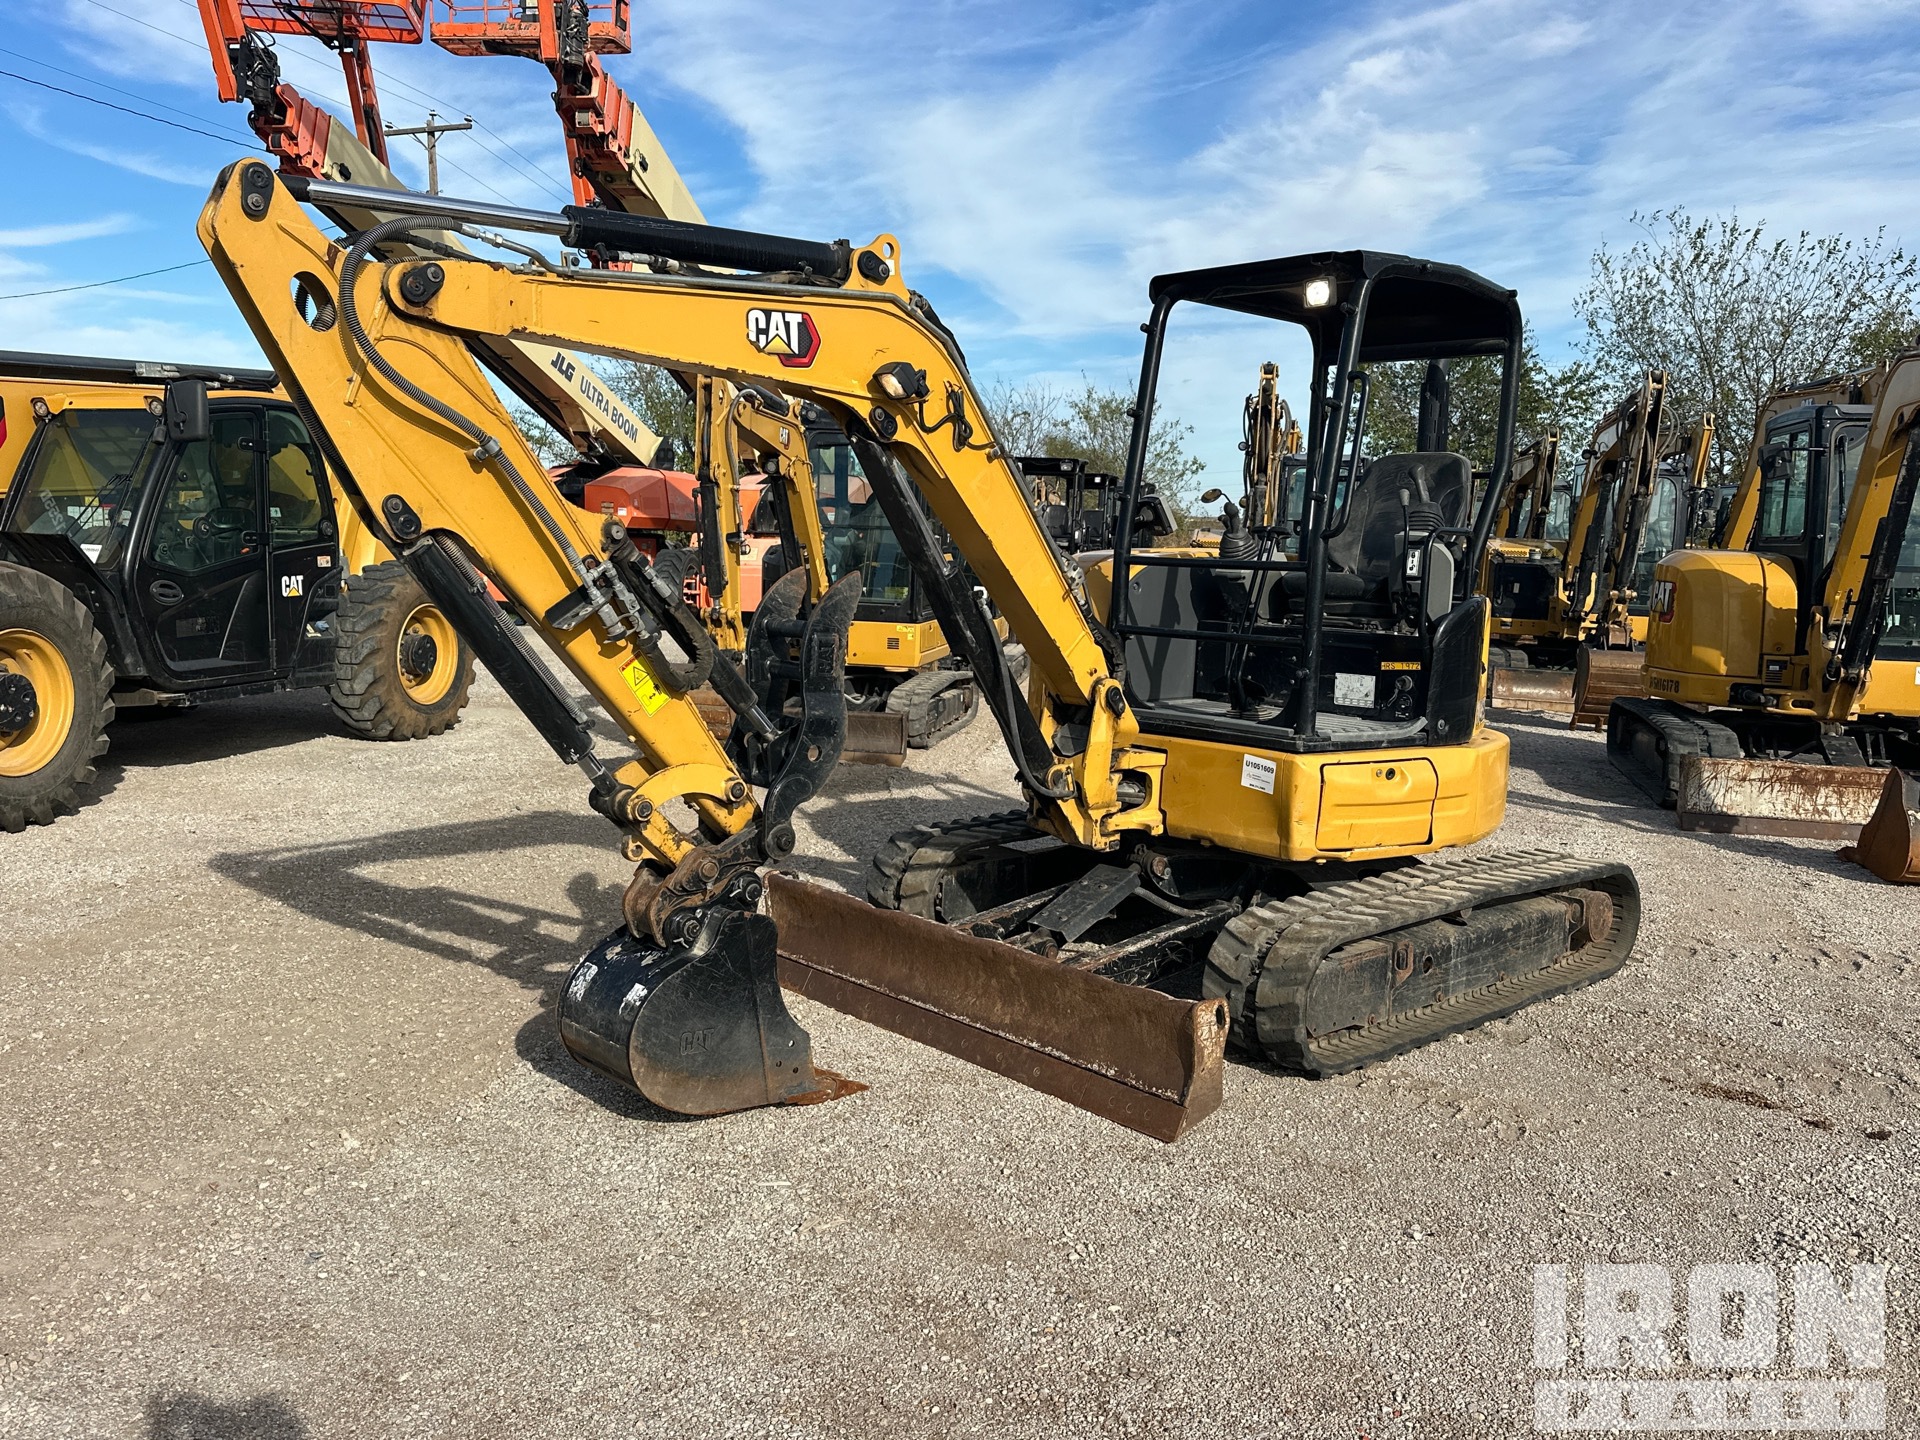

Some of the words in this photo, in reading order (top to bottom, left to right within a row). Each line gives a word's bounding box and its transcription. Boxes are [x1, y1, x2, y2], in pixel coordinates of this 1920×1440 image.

[498, 22, 515, 31] JLG
[748, 309, 803, 355] CAT
[550, 351, 576, 383] JLG
[580, 375, 610, 417] ULTRA
[610, 405, 639, 444] BOOM
[779, 426, 789, 446] CAT
[281, 574, 304, 598] CAT
[1652, 580, 1673, 613] CAT
[1400, 662, 1420, 670] 1972
[1245, 759, 1275, 775] U1051609
[680, 1027, 715, 1056] CAT
